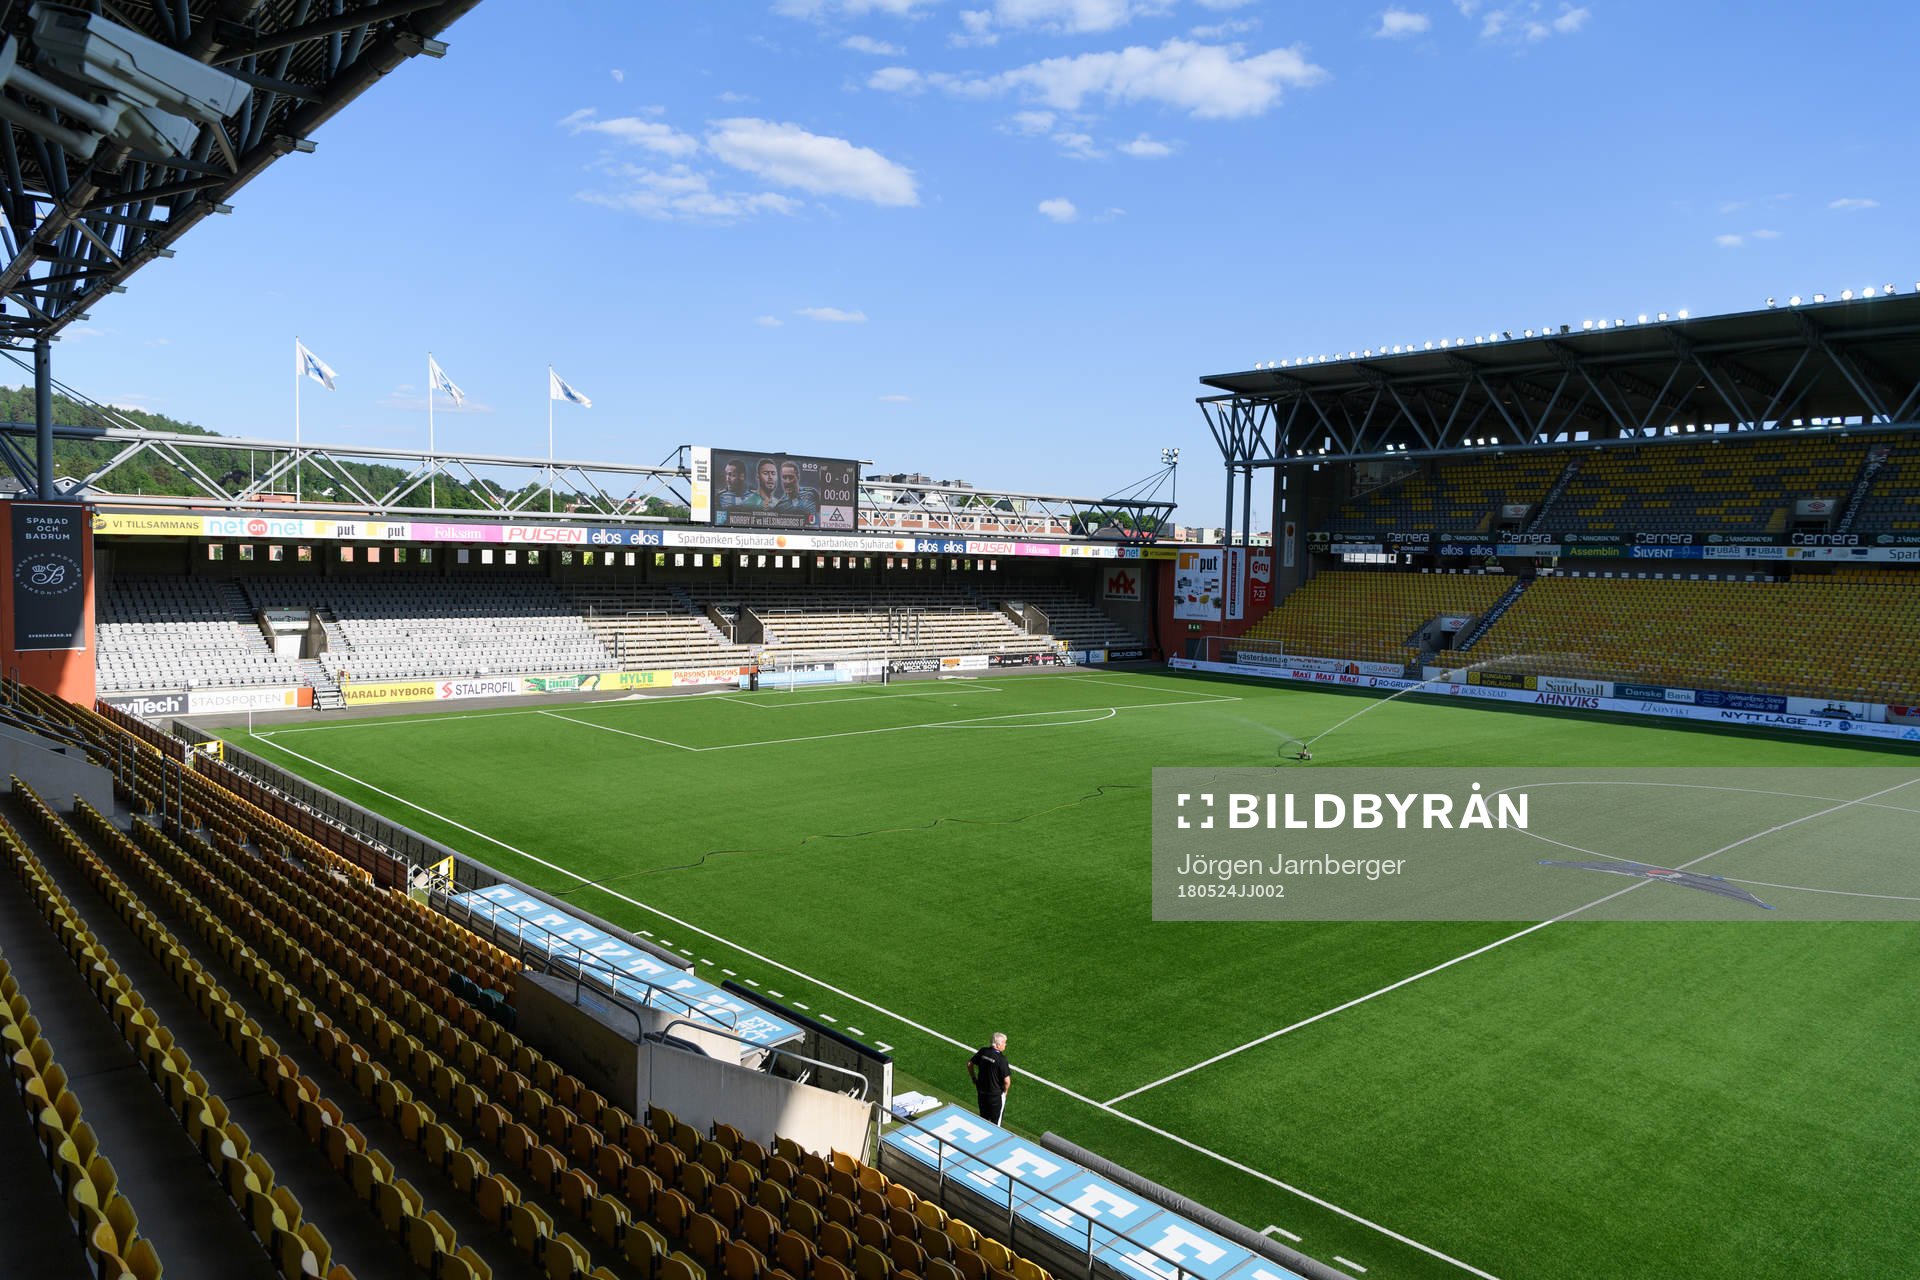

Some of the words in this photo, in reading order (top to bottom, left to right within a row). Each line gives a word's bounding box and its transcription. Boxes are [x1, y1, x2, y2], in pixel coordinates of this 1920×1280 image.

[824, 489, 850, 501] 00:00
[26, 517, 69, 525] SPABAD
[113, 520, 122, 529] VI
[126, 520, 200, 530] TILLSAMMANS
[25, 533, 70, 541] BADRUM
[508, 528, 582, 542] PULSEN
[677, 533, 733, 545] Sparbanken
[1792, 533, 1859, 545] Cernera
[810, 537, 858, 549] Sparbanken
[969, 542, 1013, 553] PULSEN
[1570, 547, 1619, 557] Assemblin
[1889, 549, 1920, 560] Spar
[620, 672, 654, 684] HYLTE
[343, 688, 387, 699] HARALD
[390, 686, 434, 697] NYBORG
[1545, 680, 1604, 697] Sandwall
[1625, 688, 1662, 698] Danske
[1667, 692, 1692, 701] Bank
[191, 692, 281, 707] STADSPORTEN
[1535, 693, 1600, 709] AHNVIKS
[1721, 711, 1763, 720] NYTT
